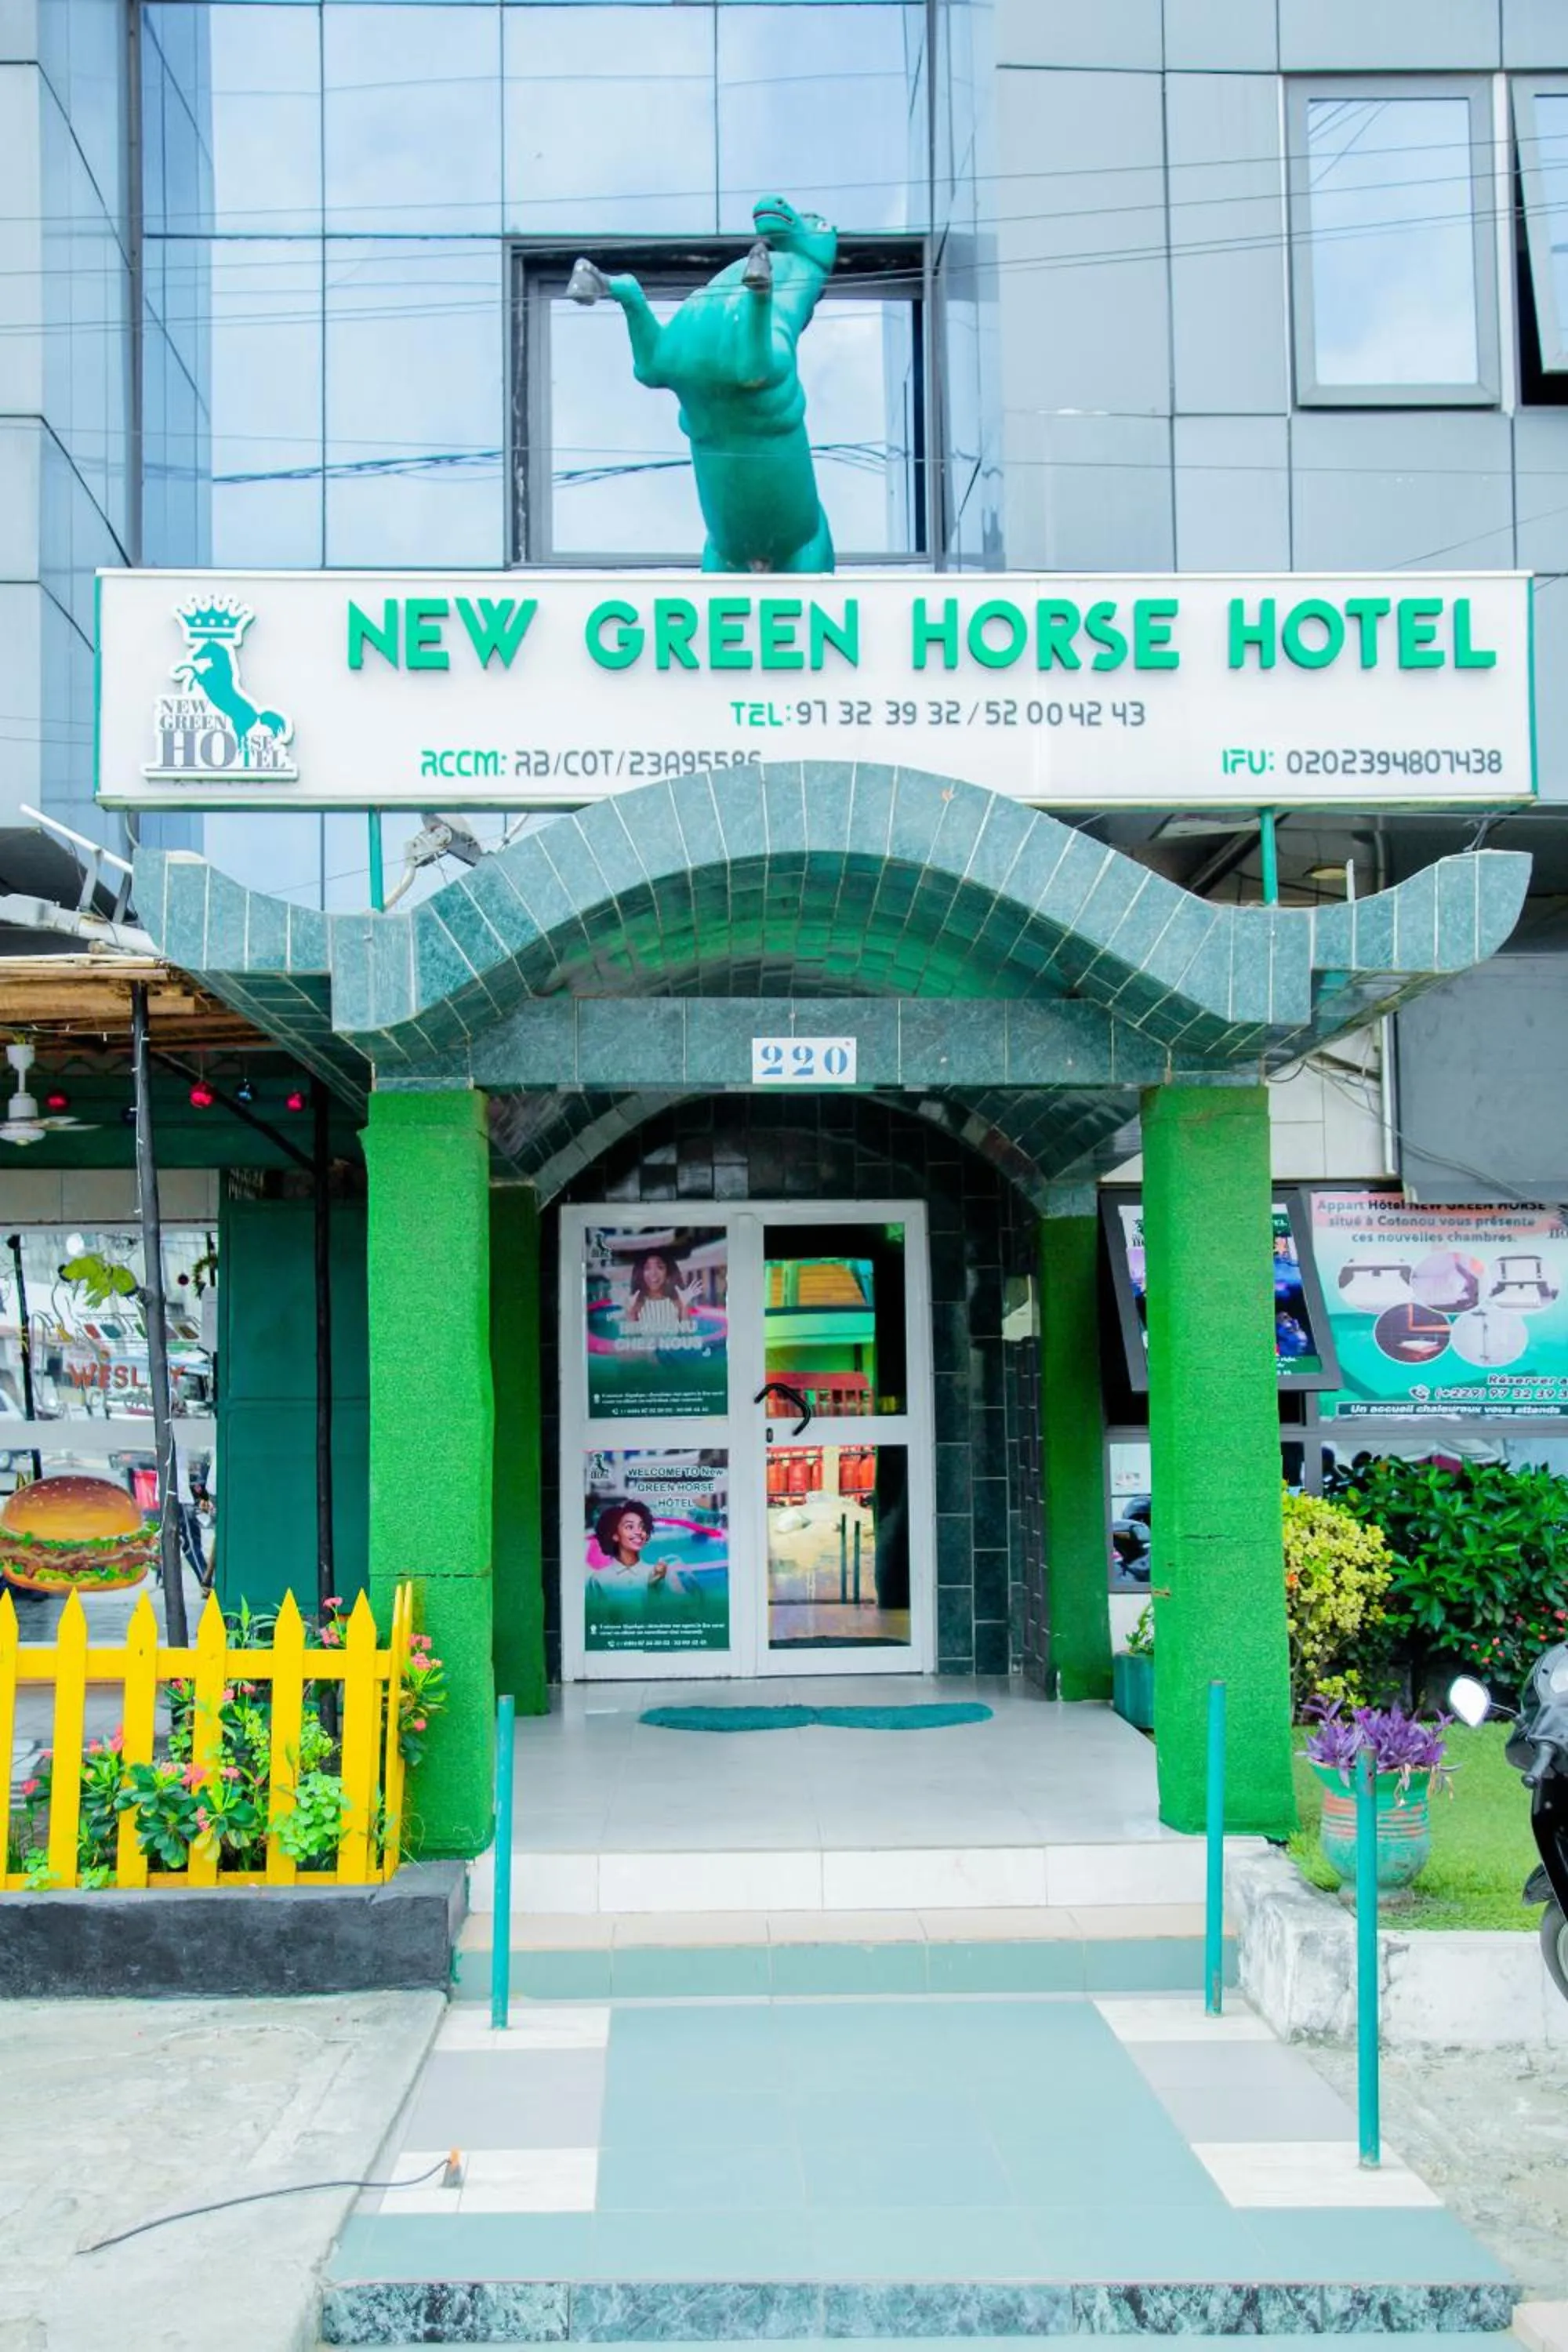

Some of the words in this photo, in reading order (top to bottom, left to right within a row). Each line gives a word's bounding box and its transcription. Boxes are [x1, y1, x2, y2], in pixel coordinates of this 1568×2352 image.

[348, 597, 539, 670] NEW
[585, 597, 859, 670] GREEN
[913, 597, 1180, 671] HORSE
[1229, 598, 1497, 670] HOTEL
[159, 699, 209, 714] NEW
[839, 702, 873, 726] 32
[884, 702, 918, 726] 39
[1027, 702, 1064, 726] 00
[1069, 702, 1102, 727] 42
[1112, 702, 1146, 727] 43
[159, 715, 227, 730] GREEN
[421, 750, 508, 776] RCCM:
[1221, 750, 1275, 775] IFU:
[1287, 749, 1503, 775] 0202394807438
[760, 1046, 848, 1076] 220
[1317, 1200, 1365, 1213] Appart
[1368, 1200, 1406, 1210] Hôtel
[1329, 1216, 1363, 1227] situé
[1377, 1216, 1436, 1227] Cotonou
[1439, 1218, 1472, 1227] vous
[1475, 1216, 1535, 1229] présente
[1352, 1233, 1373, 1243] ces
[1377, 1232, 1443, 1243] nouvelles
[67, 1363, 186, 1389] WESLY
[1350, 1404, 1367, 1414] Un
[1370, 1404, 1414, 1414] accueil
[628, 1467, 681, 1476] WELCOME
[685, 1467, 699, 1475] TO
[637, 1483, 675, 1492] GREEN
[677, 1482, 714, 1491] HORSE
